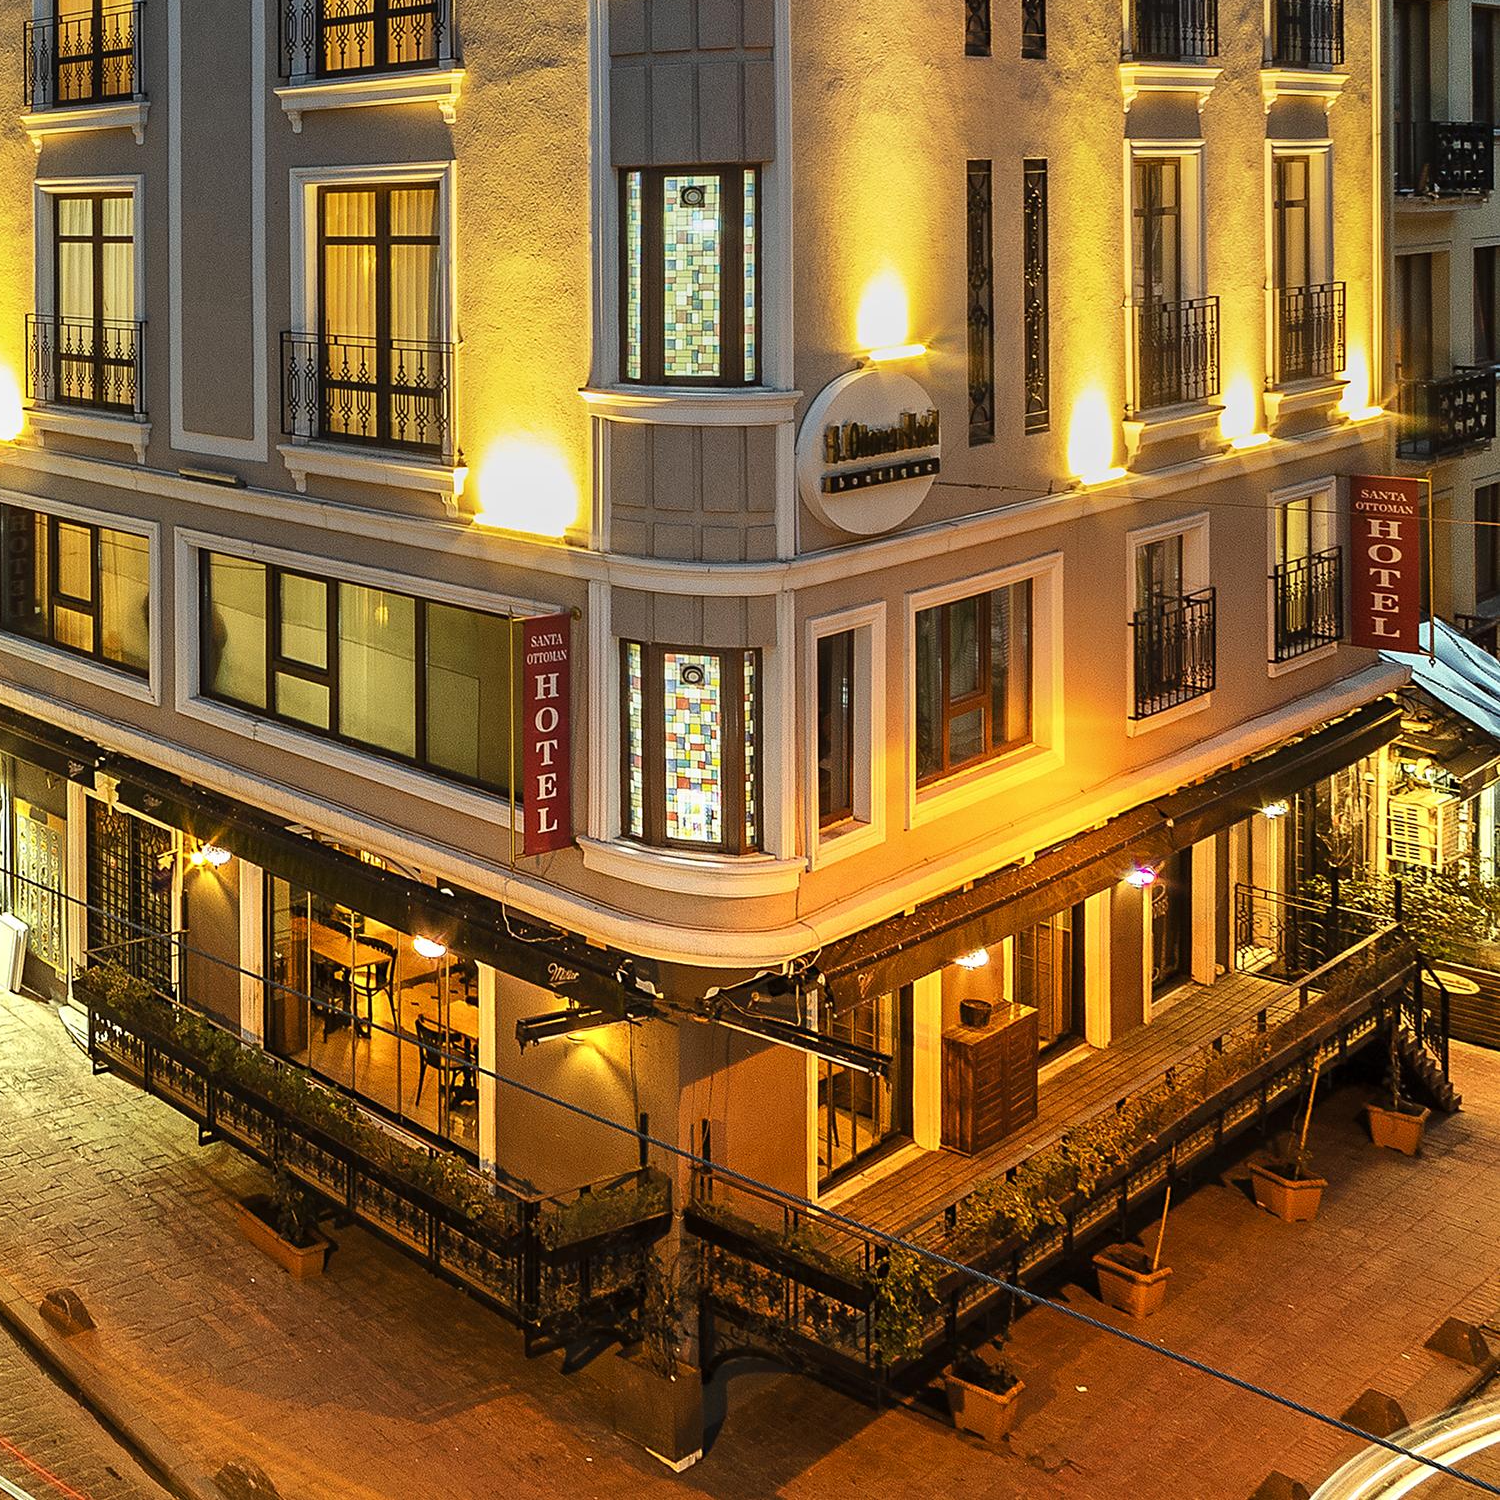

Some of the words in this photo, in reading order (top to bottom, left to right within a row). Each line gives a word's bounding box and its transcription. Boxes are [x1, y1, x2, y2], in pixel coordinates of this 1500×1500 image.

[838, 463, 933, 489] boutique
[1360, 489, 1407, 502] SANTA
[1355, 501, 1414, 515] OTTOMAN
[1366, 518, 1403, 638] HOTEL
[530, 633, 563, 648] SANTA
[526, 649, 567, 665] OTTOMAN
[534, 672, 560, 834] HOTEL
